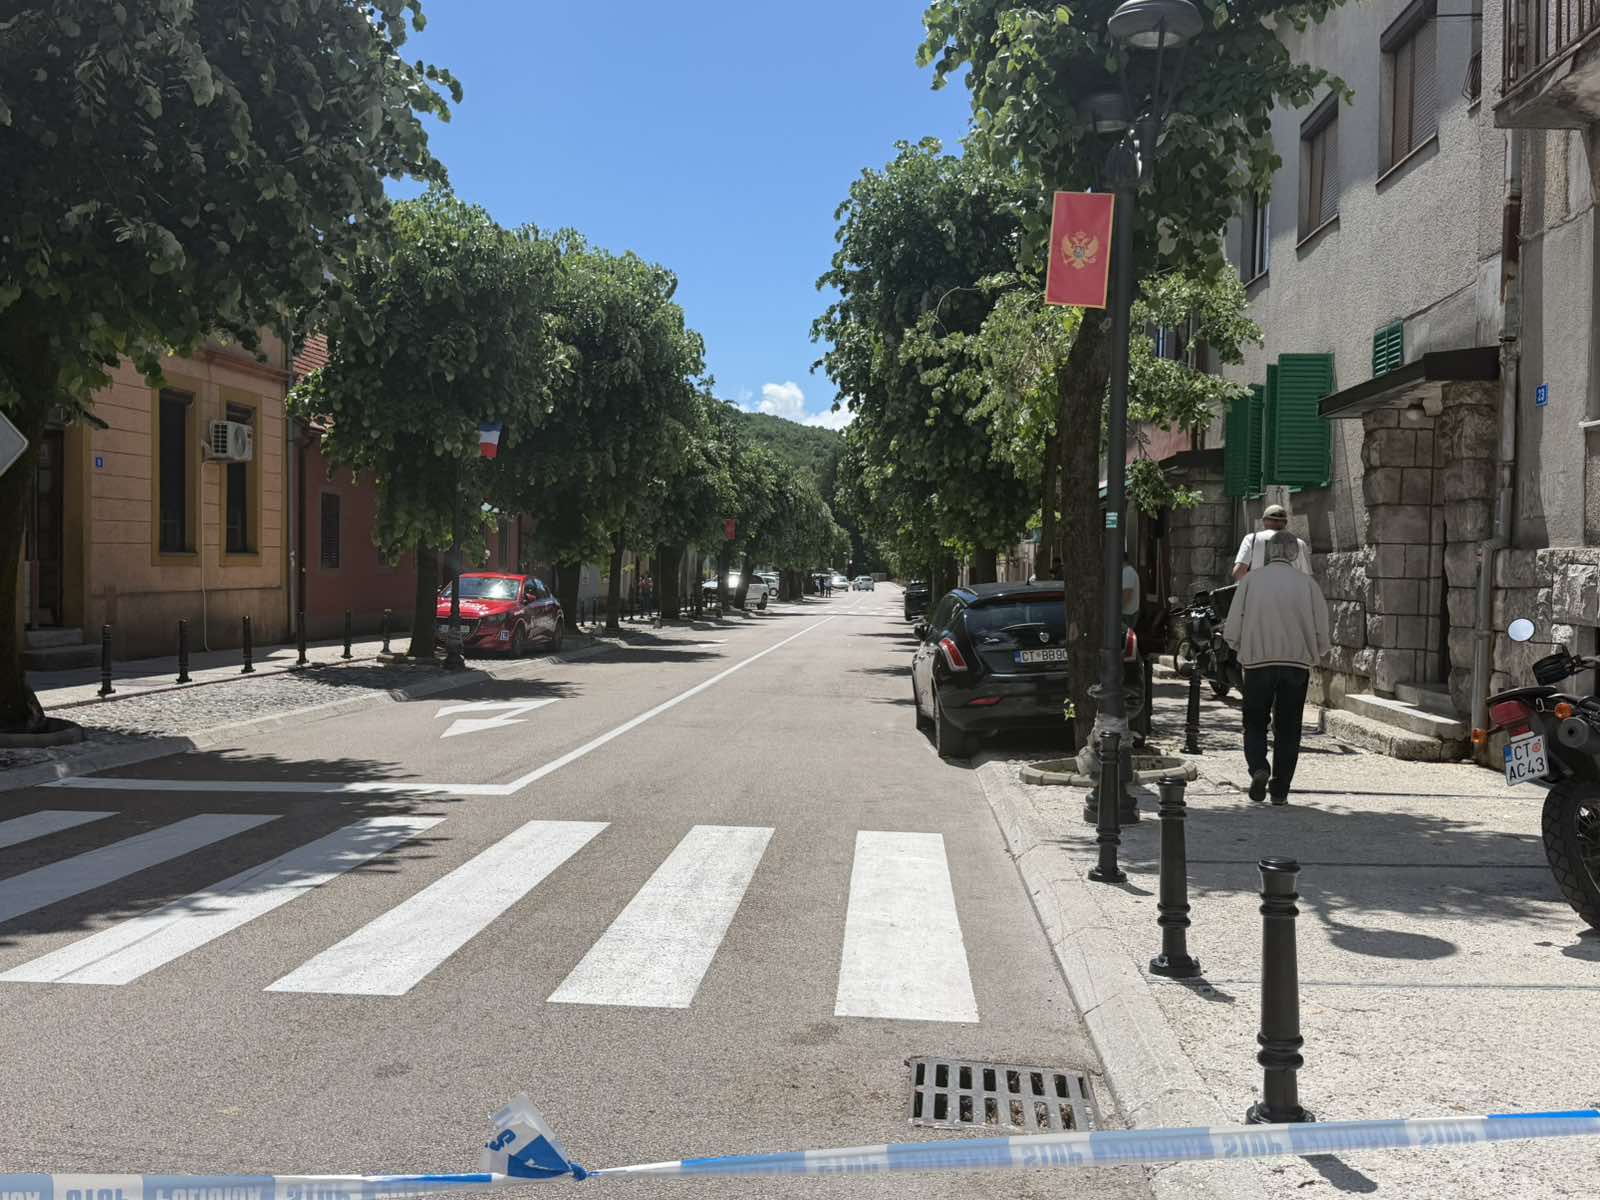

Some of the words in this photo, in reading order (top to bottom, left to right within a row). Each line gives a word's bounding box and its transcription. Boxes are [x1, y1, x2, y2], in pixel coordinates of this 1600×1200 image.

[1023, 651, 1034, 662] CT
[1514, 742, 1531, 761] CT
[1509, 757, 1545, 781] AC43
